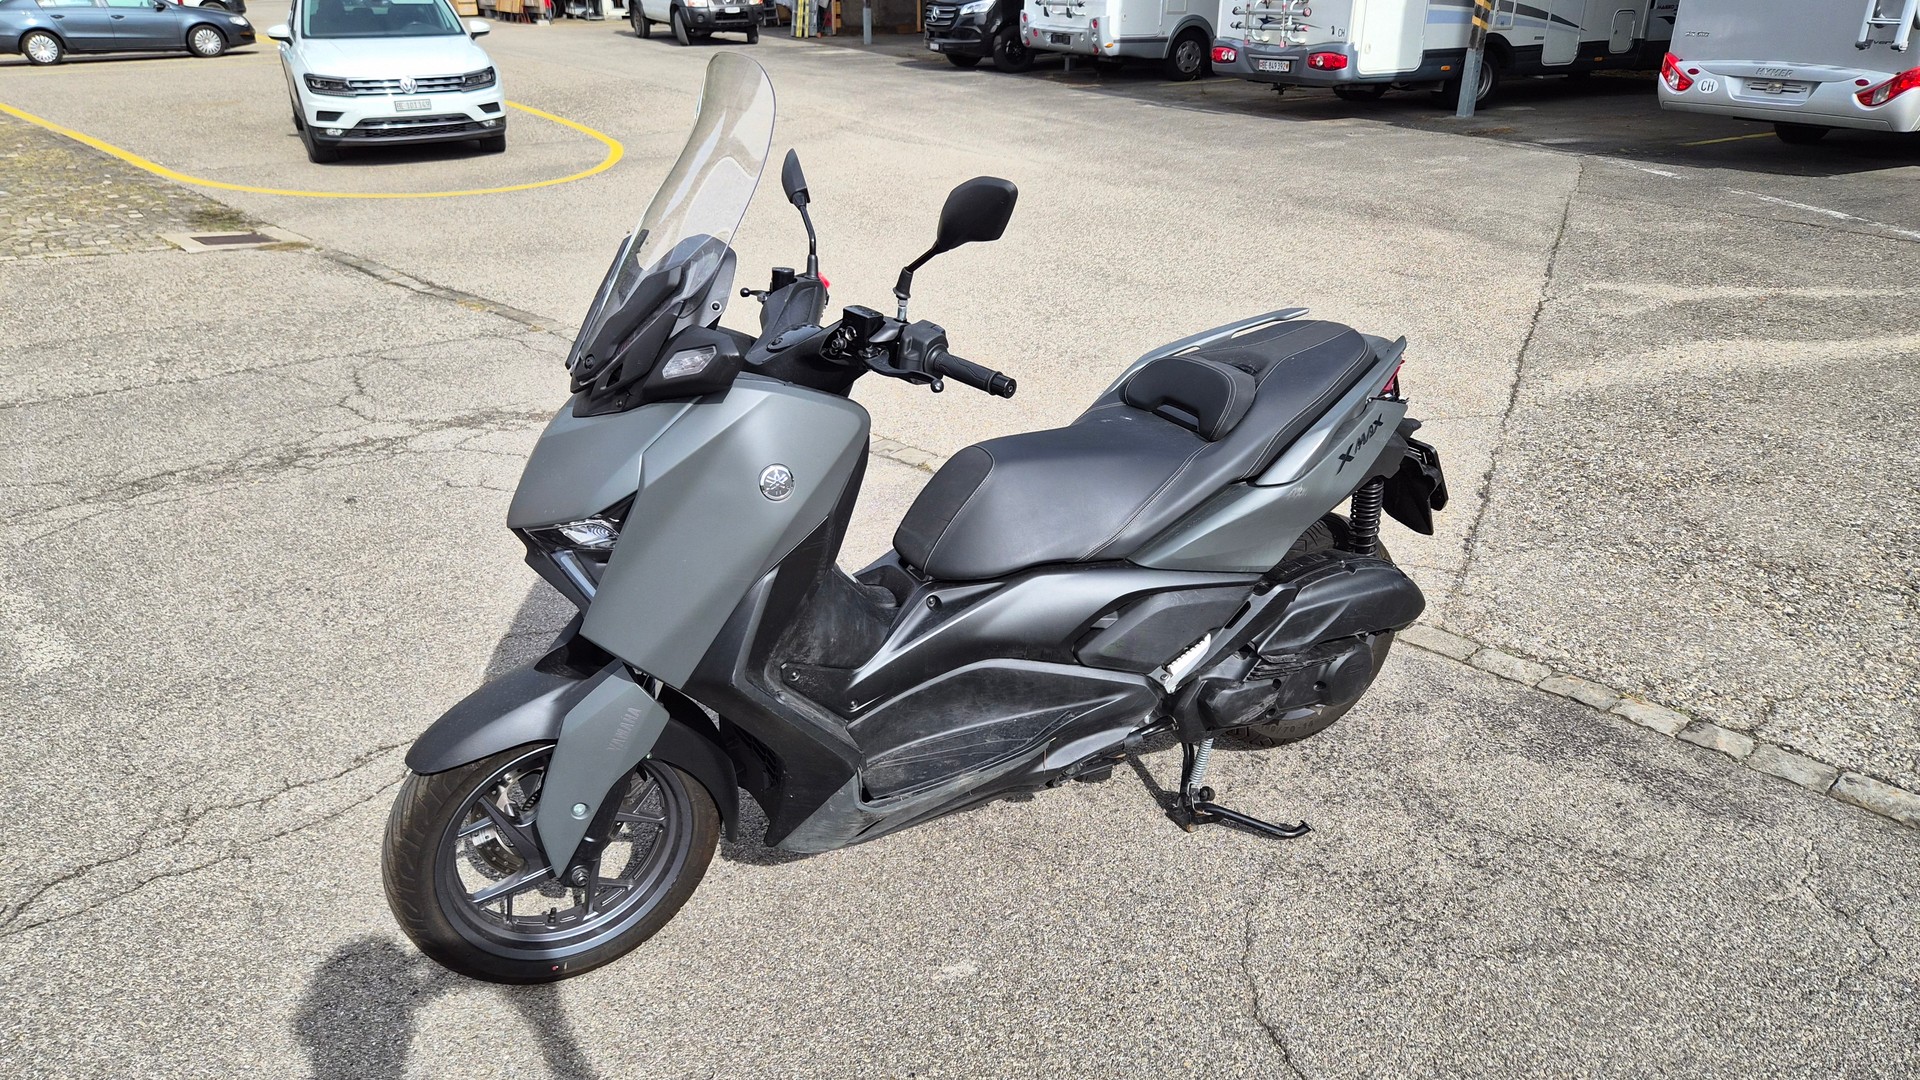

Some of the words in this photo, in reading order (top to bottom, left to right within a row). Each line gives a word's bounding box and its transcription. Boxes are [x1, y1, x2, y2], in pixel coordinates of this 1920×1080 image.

[1756, 67, 1793, 77] HYMER
[1700, 81, 1714, 91] CH
[607, 707, 642, 751] YAMAHA
